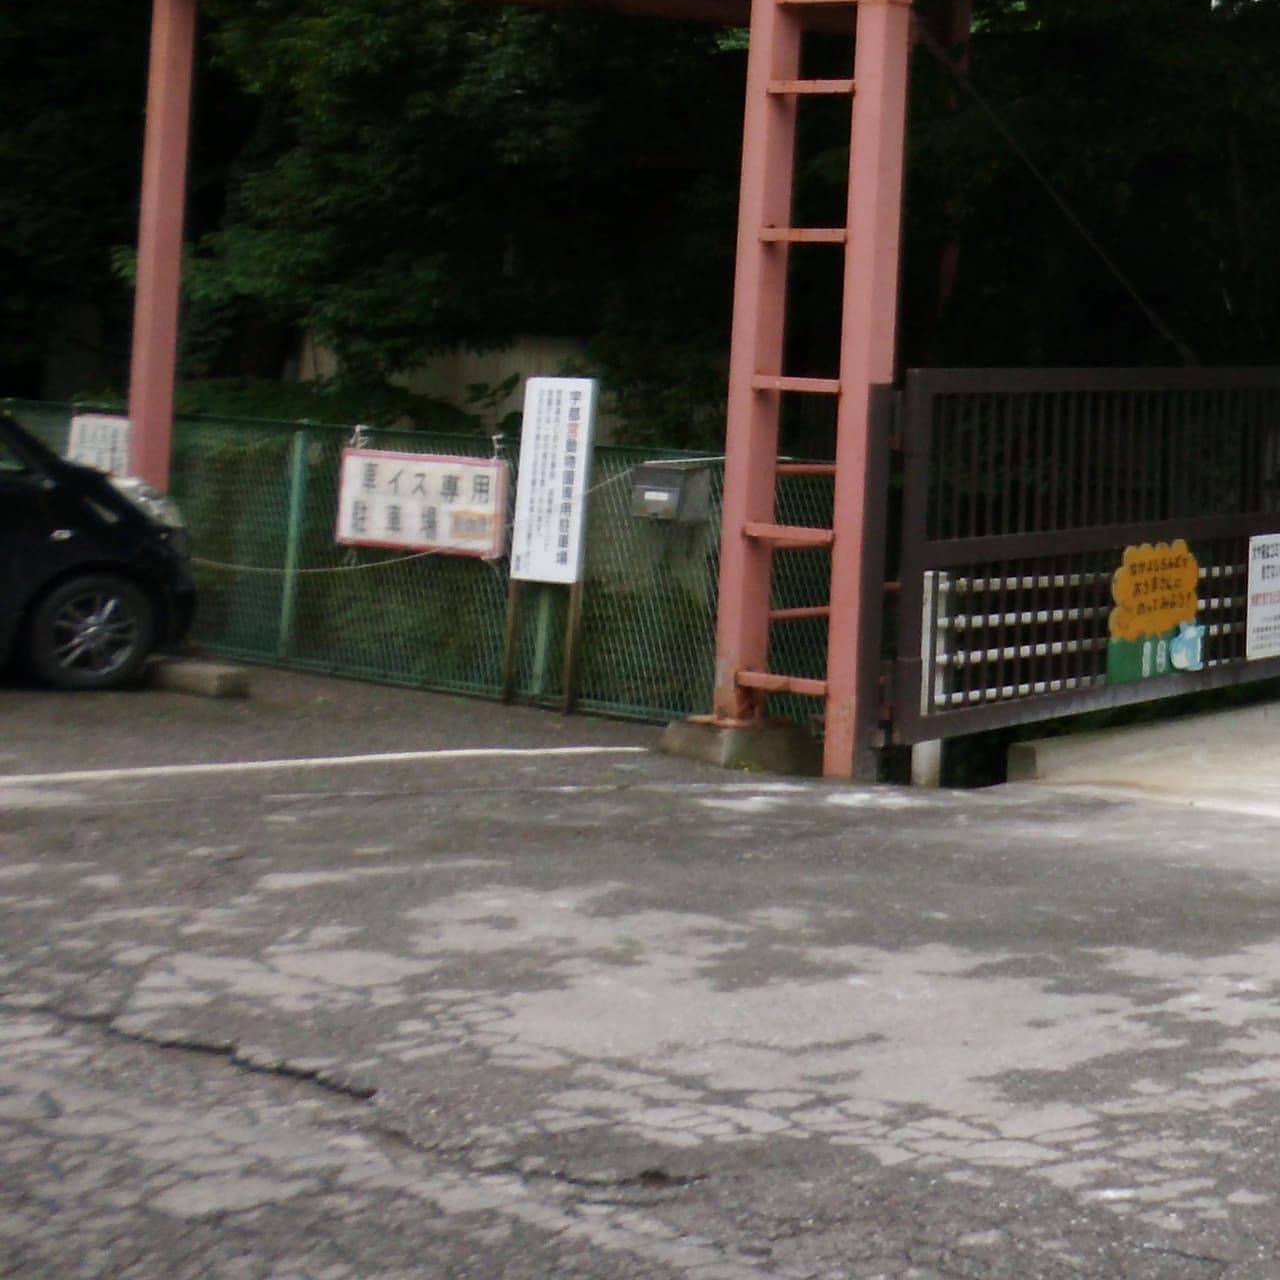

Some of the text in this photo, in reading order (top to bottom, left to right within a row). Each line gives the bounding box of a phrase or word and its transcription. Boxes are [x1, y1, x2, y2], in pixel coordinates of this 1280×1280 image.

[361, 462, 490, 504] 車イス専用
[351, 500, 438, 541] 駐車場
